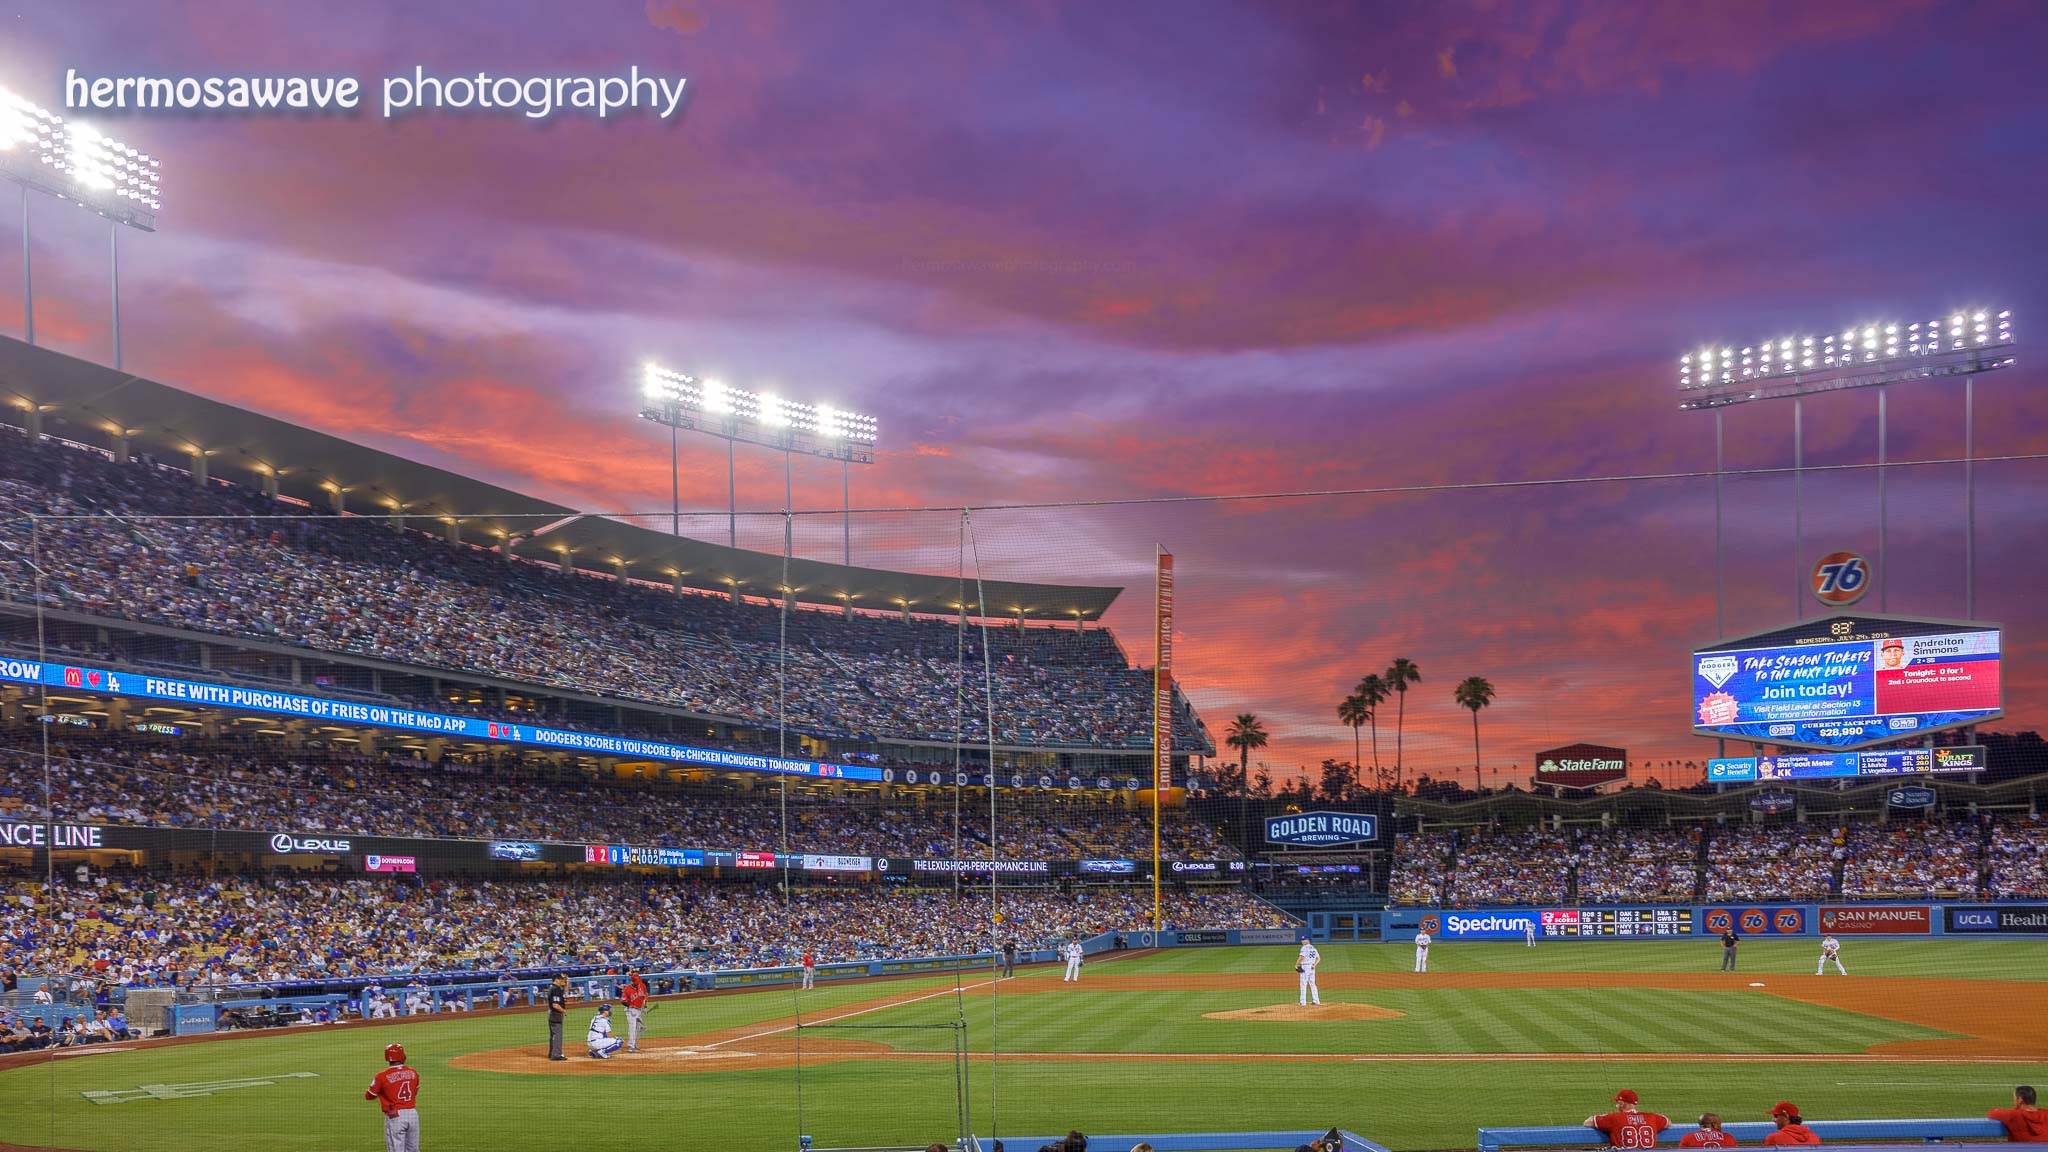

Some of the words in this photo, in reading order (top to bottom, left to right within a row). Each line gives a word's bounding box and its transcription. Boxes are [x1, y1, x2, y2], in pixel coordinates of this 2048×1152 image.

[1817, 557, 1865, 593] 76
[1159, 616, 1170, 670] Emirates
[1913, 638, 1964, 648] Andrelton
[1913, 646, 1959, 656] Simmons
[1743, 657, 1773, 671] TAKE
[1774, 653, 1821, 669] SEASON
[1824, 651, 1871, 663] TICKETS
[0, 660, 40, 680] ROW
[1755, 671, 1768, 683] TO
[1770, 669, 1790, 681] THE
[1793, 666, 1823, 680] NEXT
[1825, 665, 1858, 677] LEVEL
[1947, 674, 1971, 682] second
[1762, 685, 1795, 700] Join
[1799, 681, 1852, 701] today!
[146, 679, 186, 697] FREE
[189, 684, 229, 703] WITH
[232, 689, 309, 713] PURCHASE
[311, 701, 329, 715] OF
[332, 703, 368, 720] FRIES
[371, 709, 389, 722] ON
[391, 711, 415, 726] THE
[417, 716, 441, 729] McD
[444, 719, 466, 732] APP
[1753, 705, 1771, 713] Visit
[1771, 703, 1789, 712] Field
[1790, 702, 1812, 711] Level
[1821, 700, 1852, 709] Section
[1767, 711, 1778, 719] for
[1779, 711, 1800, 719] more
[1158, 719, 1170, 734] FLY
[1801, 721, 1841, 729] CURRENT
[1819, 727, 1863, 737] $28,990
[536, 729, 582, 746] DODGERS
[583, 737, 615, 750] SCORE
[615, 741, 622, 751] 6
[622, 741, 641, 753] YOU
[641, 743, 670, 757] SCORE
[671, 748, 686, 760] 6pc
[686, 751, 721, 763] CHICKEN
[721, 755, 767, 768] MCNUGGETS
[1158, 737, 1170, 791] Emirates
[1811, 759, 1834, 767] Meter
[1940, 754, 1973, 762] DRAFT
[1726, 762, 1752, 770] Security
[1777, 769, 1792, 777] KK
[1271, 816, 1327, 838] GOLDEN
[1332, 816, 1371, 836] ROAD
[0, 823, 45, 845] NCE
[53, 825, 103, 847] LINE
[1301, 834, 1340, 842] BREWING
[293, 839, 351, 850] LEXUS
[600, 848, 606, 862] 2
[612, 849, 618, 862] 0
[914, 860, 927, 870] THE
[928, 861, 950, 870] LEXUS
[1030, 862, 1047, 871] LINE
[1709, 913, 1729, 928] 76
[1744, 913, 1763, 928] 76
[1778, 913, 1798, 928] 76
[1838, 911, 1865, 921] SAN
[1868, 911, 1925, 920] MANUEL
[1959, 914, 1993, 925] UCLA
[1422, 919, 1438, 929] 76
[1447, 915, 1531, 935] Spectrum
[397, 1080, 412, 1102] 4
[1621, 1126, 1655, 1149] 88
